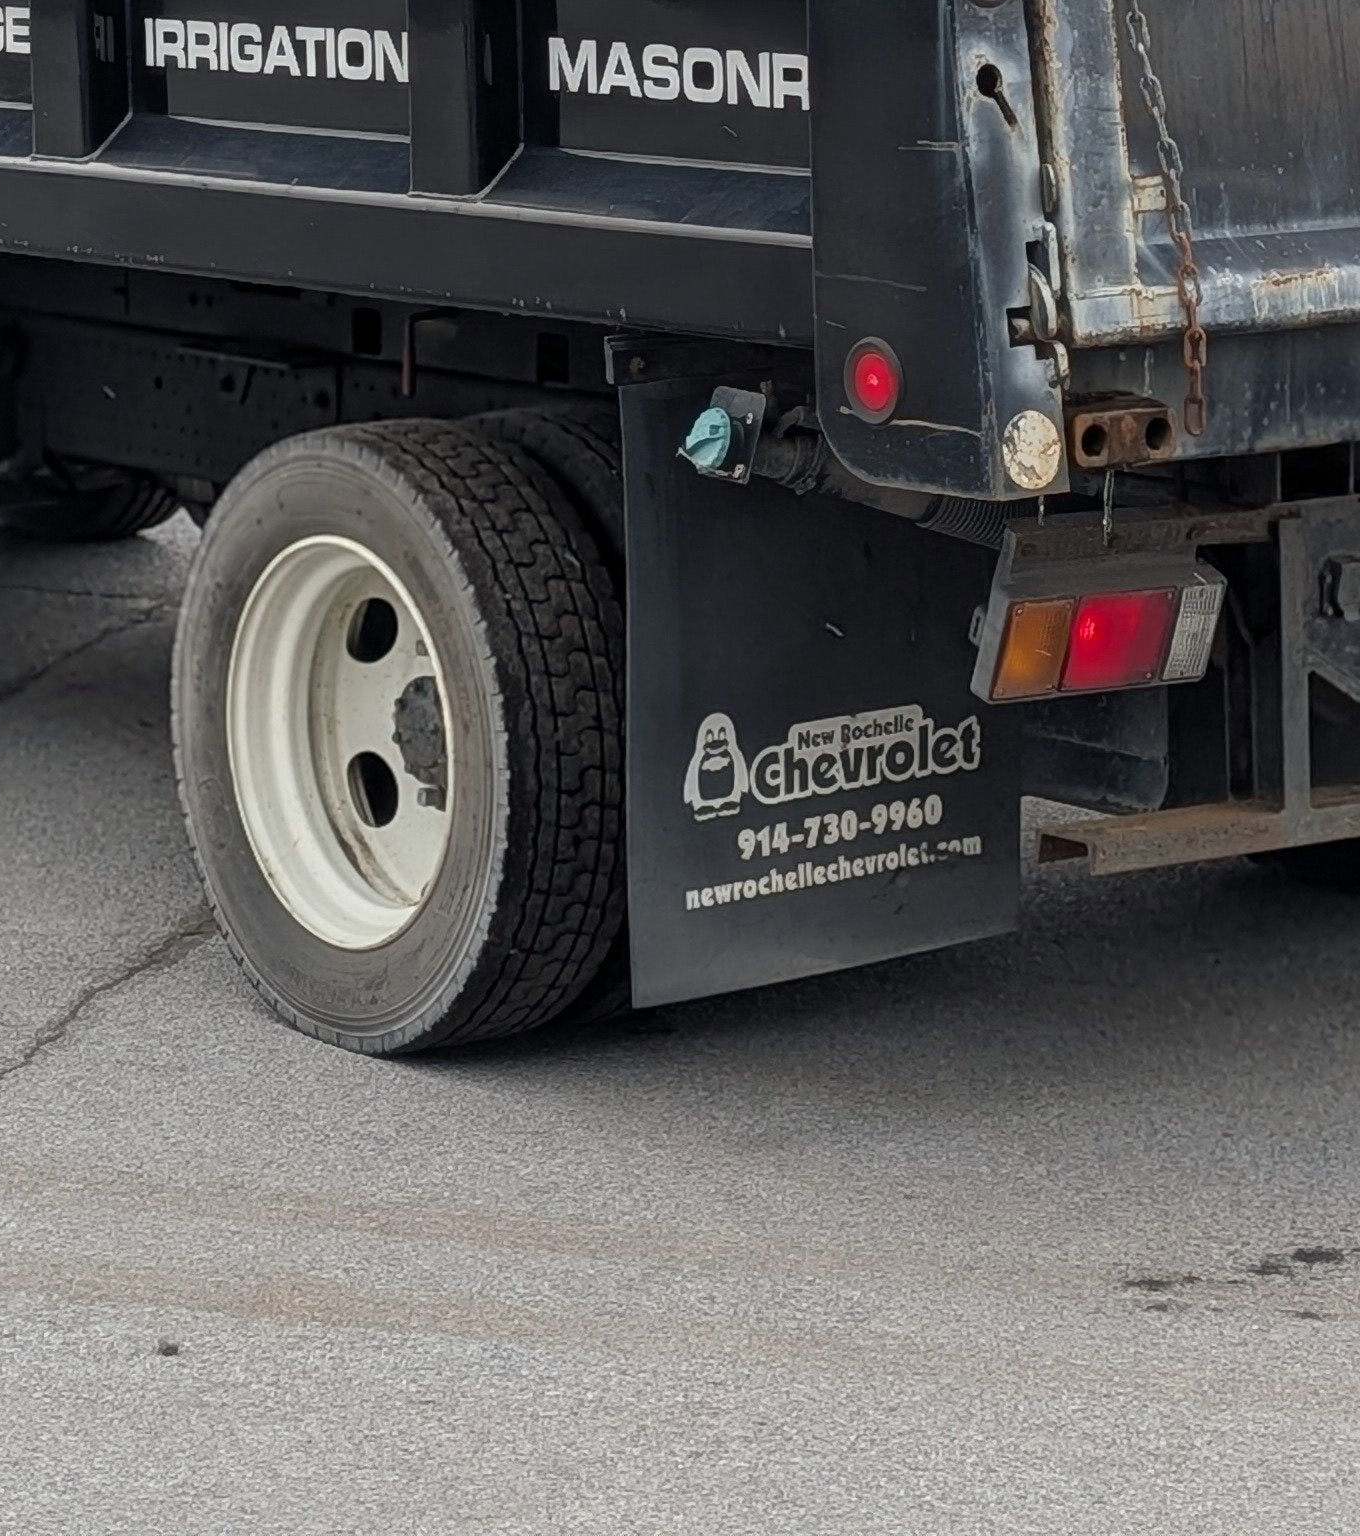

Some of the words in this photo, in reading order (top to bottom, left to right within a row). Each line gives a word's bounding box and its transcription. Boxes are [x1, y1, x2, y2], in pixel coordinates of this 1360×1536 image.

[144, 17, 409, 83] IRRIGATION
[548, 37, 810, 111] MASONR
[797, 729, 835, 751] New
[737, 794, 943, 861] 914-730-9960
